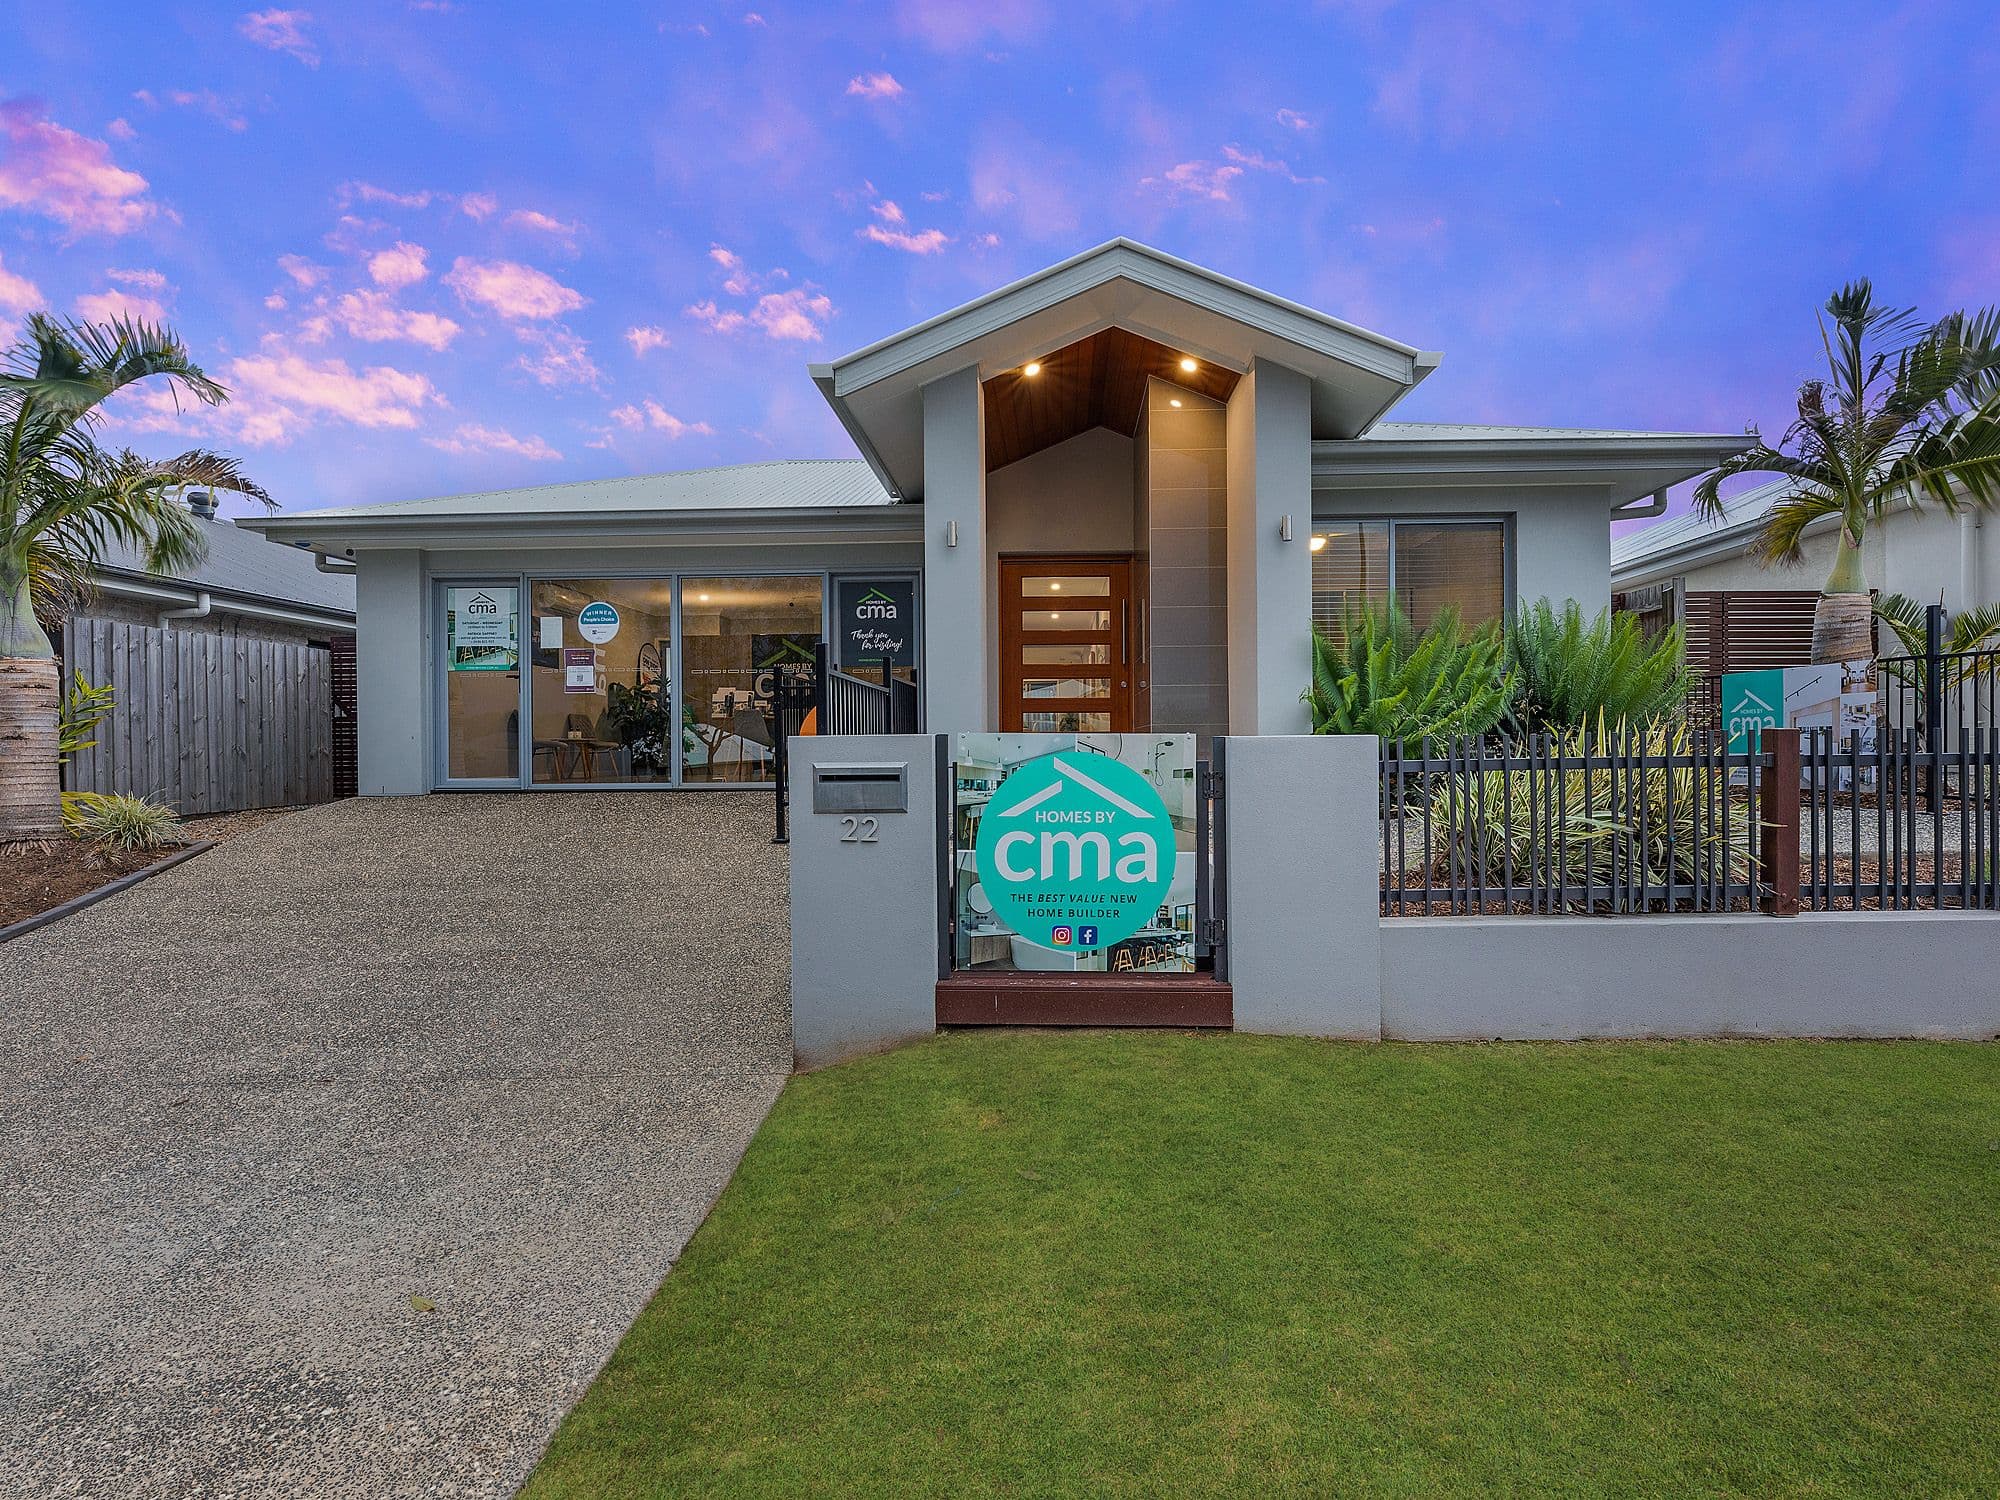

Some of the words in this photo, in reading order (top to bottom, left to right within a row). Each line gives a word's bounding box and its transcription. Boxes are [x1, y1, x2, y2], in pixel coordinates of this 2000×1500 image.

[468, 603, 497, 614] cma
[856, 605, 897, 619] cma
[850, 628, 874, 641] Thank
[873, 632, 890, 644] you
[861, 639, 874, 651] for
[874, 637, 903, 652] visiting!
[1035, 810, 1092, 824] HOMES
[1095, 810, 1116, 824] BY
[840, 815, 879, 843] 22
[994, 830, 1158, 883] cma
[1010, 893, 1033, 903] THE
[1037, 893, 1066, 904] BEST
[1069, 893, 1106, 904] VALUE
[1110, 894, 1138, 904] NEW
[1027, 908, 1063, 918] HOME
[1068, 908, 1121, 919] BUILDER
